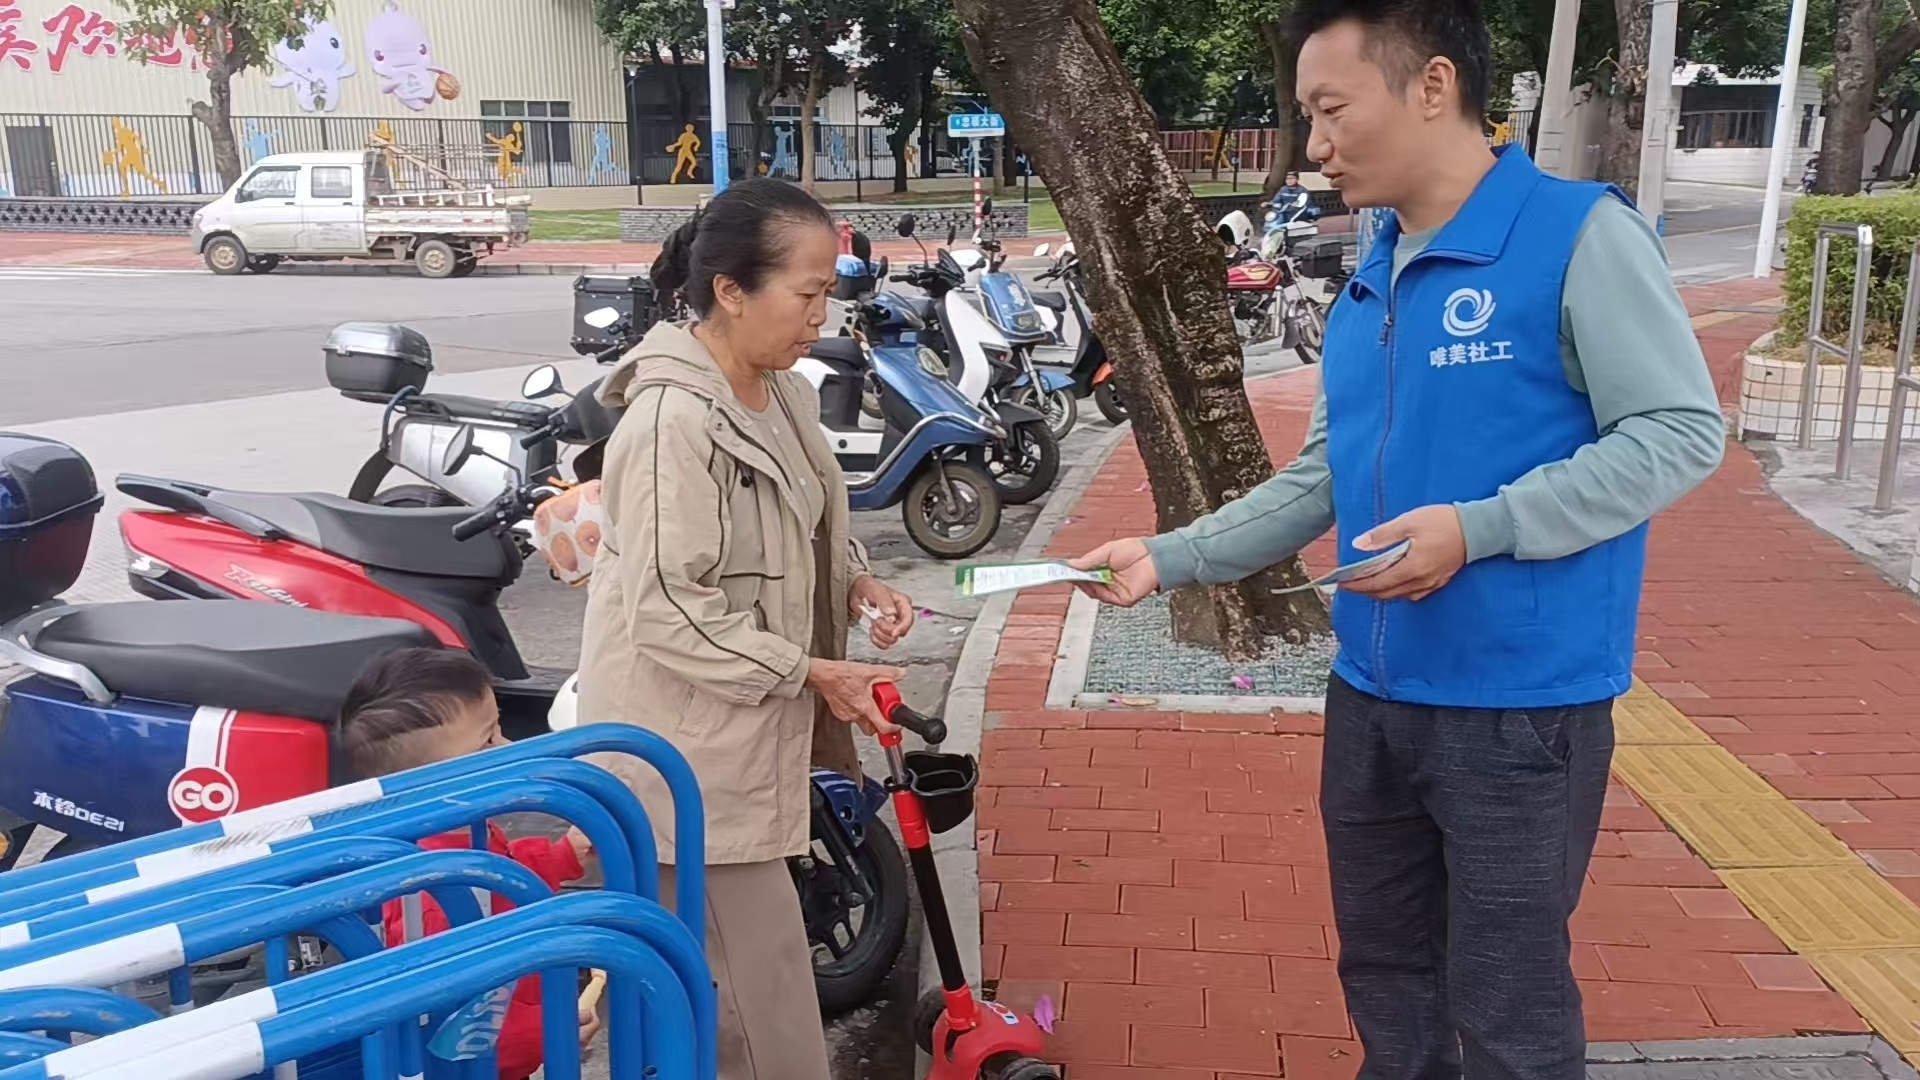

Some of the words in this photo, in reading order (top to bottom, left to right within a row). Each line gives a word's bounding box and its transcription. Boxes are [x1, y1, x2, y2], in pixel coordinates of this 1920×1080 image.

[1429, 341, 1514, 368] 唯美社工
[173, 780, 233, 812] GO
